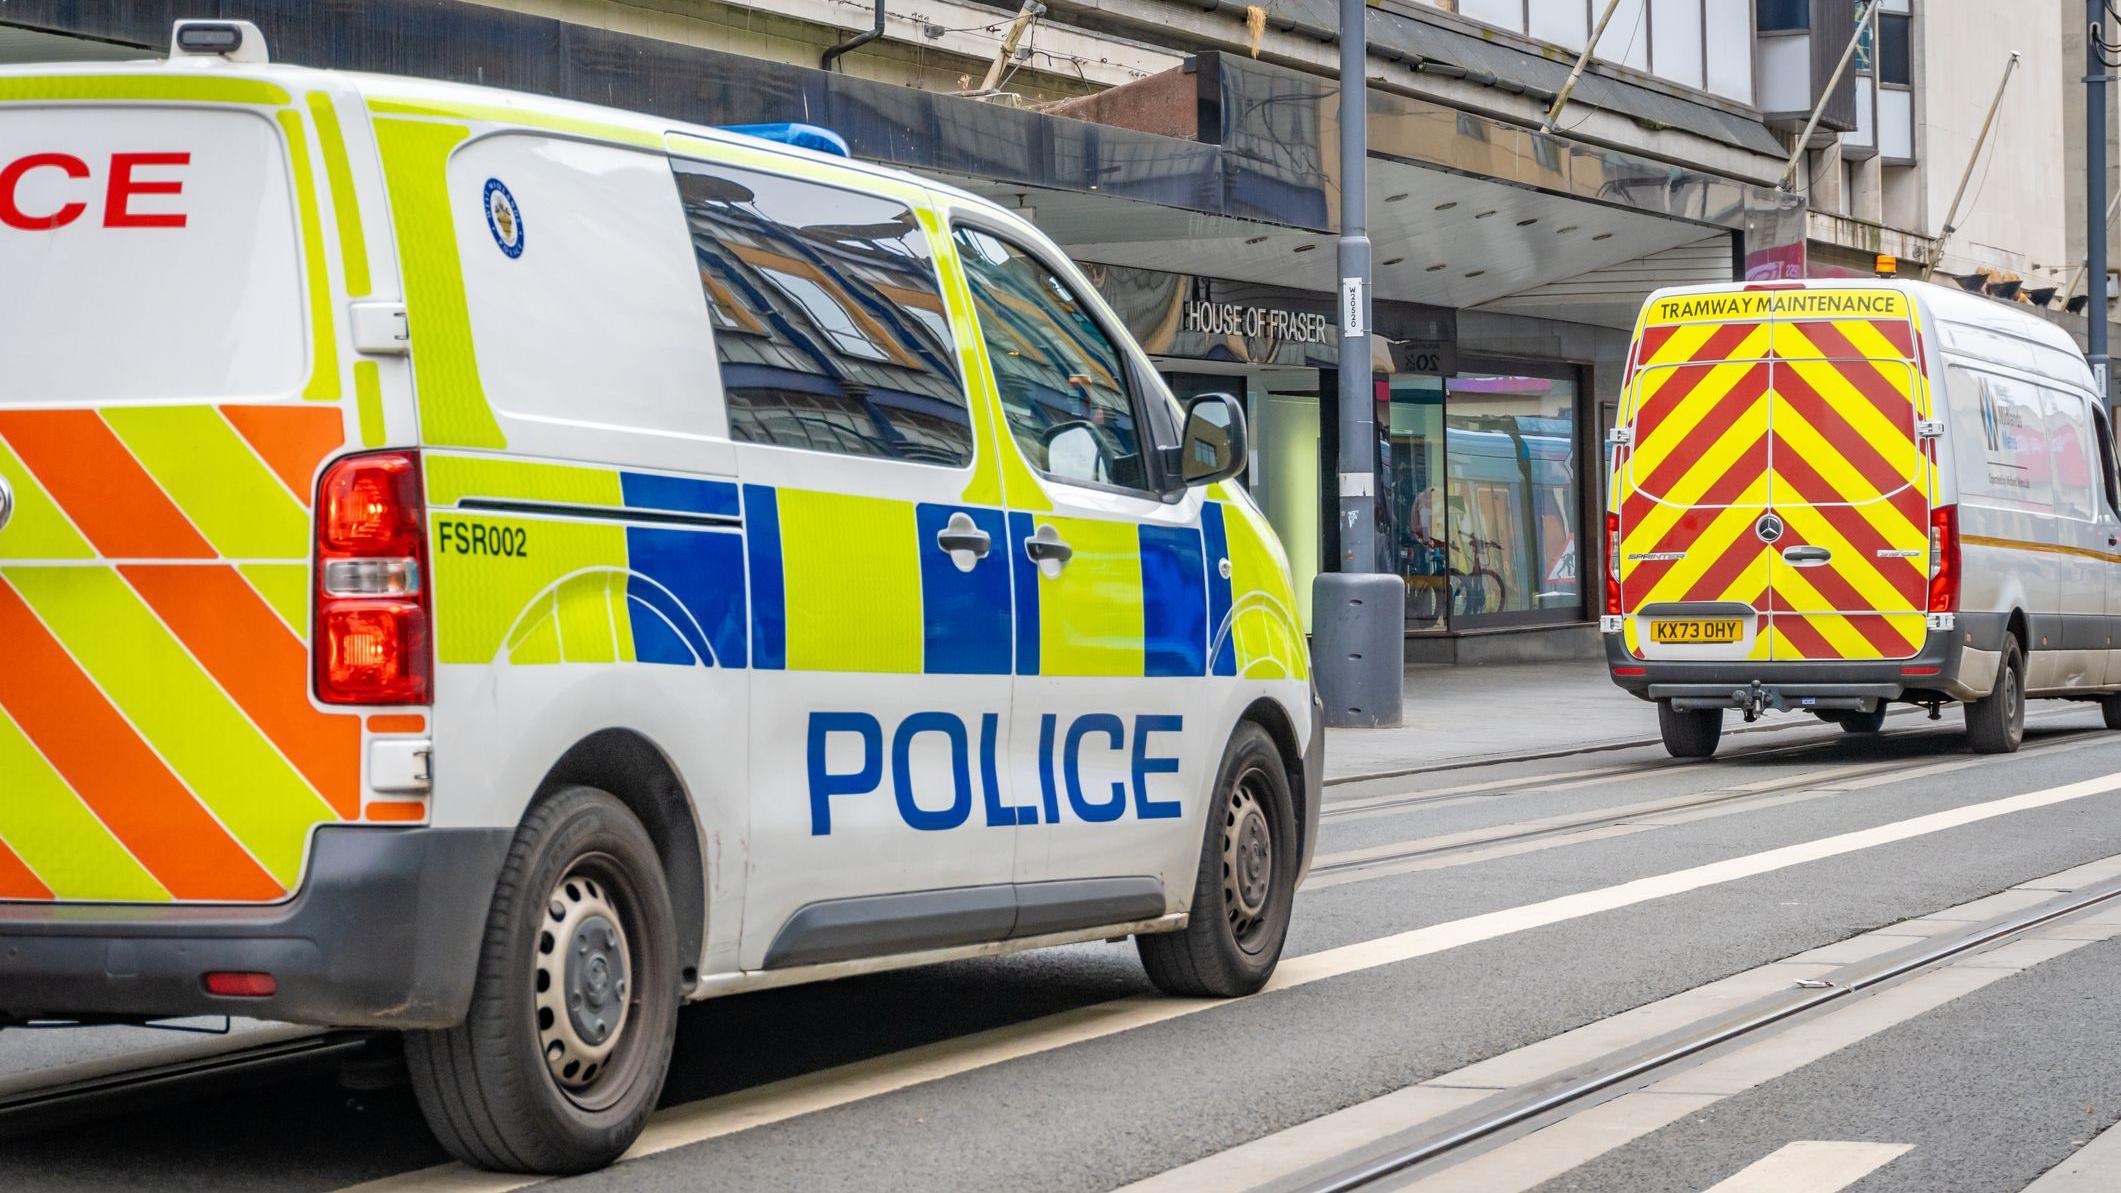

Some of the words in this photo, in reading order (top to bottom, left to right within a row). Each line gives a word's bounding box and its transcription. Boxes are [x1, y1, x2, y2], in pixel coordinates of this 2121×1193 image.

[0, 152, 191, 231] CE
[1190, 301, 1243, 335] HOUSE
[1247, 307, 1267, 338] OF
[1270, 309, 1326, 343] FRASER
[1661, 297, 1753, 320] TRAMWAY
[1756, 296, 1895, 313] MAINTENANCE
[439, 522, 527, 557] FSR002
[1657, 622, 1700, 639] KX73
[1704, 622, 1737, 638] OHY
[807, 711, 1184, 836] POLICE
